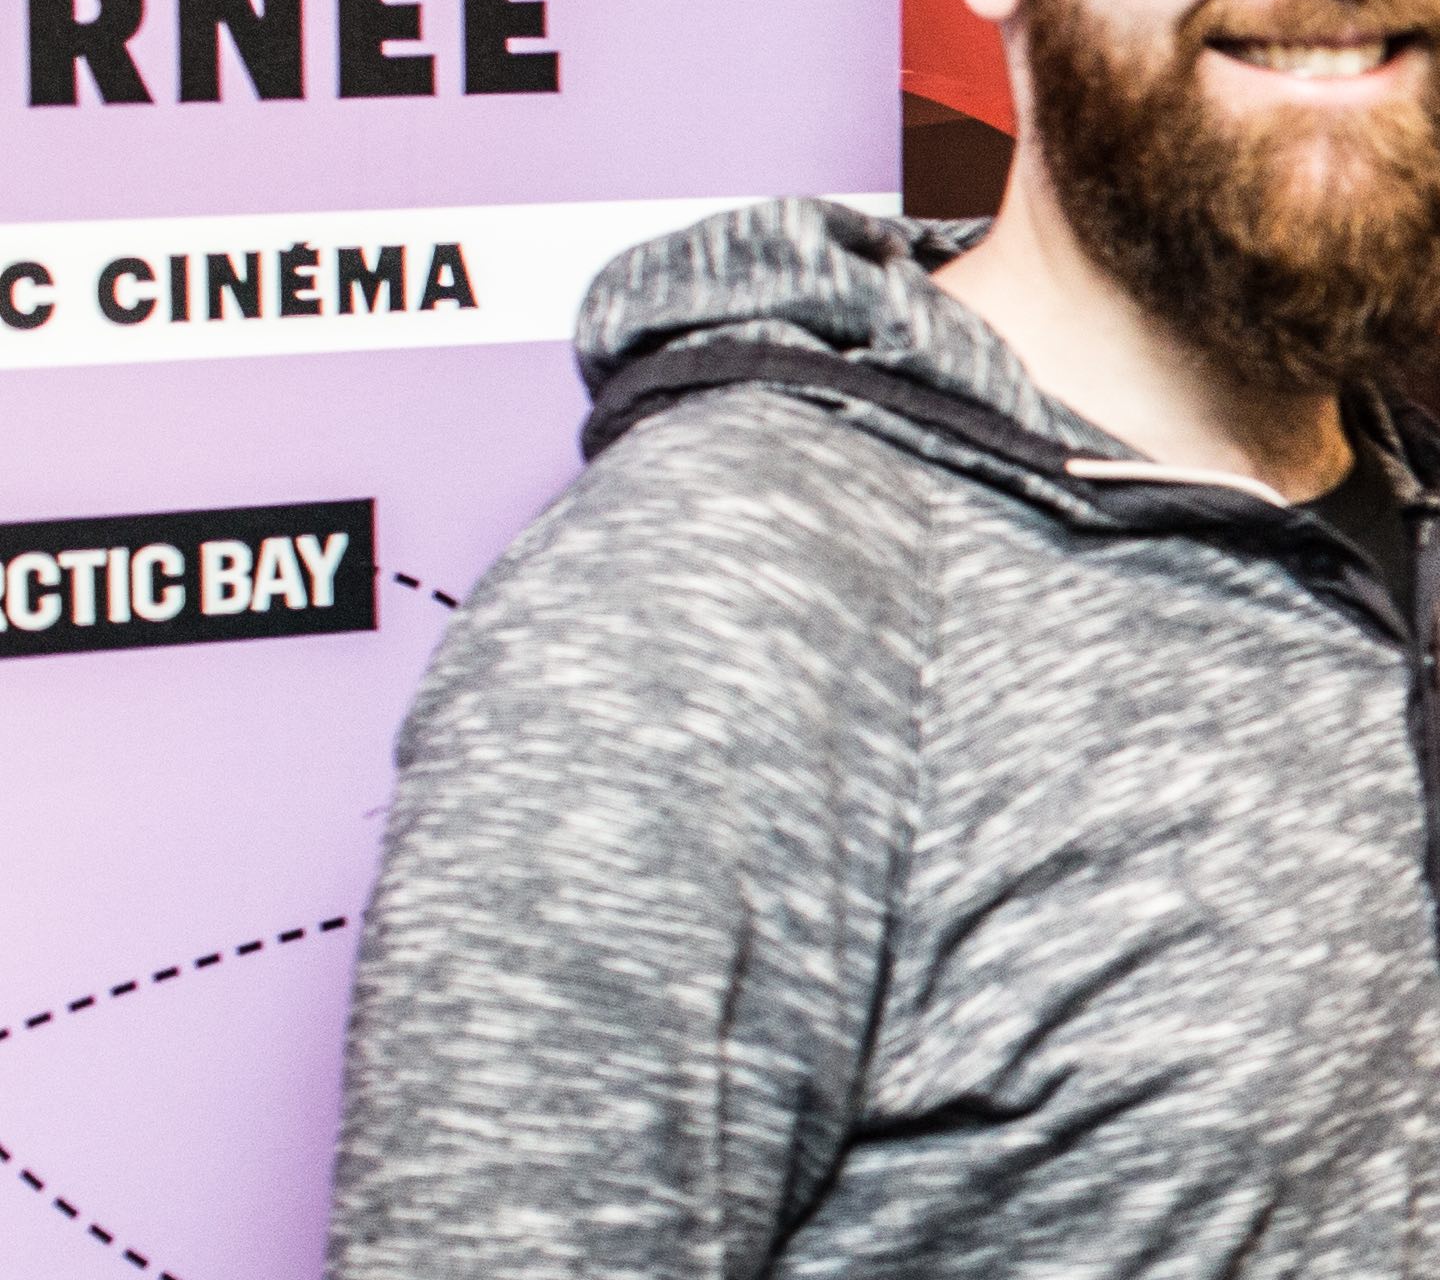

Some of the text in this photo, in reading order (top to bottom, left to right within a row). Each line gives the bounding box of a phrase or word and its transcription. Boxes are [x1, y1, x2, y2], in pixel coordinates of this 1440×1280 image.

[97, 240, 480, 326] CINÉMA
[0, 533, 351, 633] CTIC BAY
